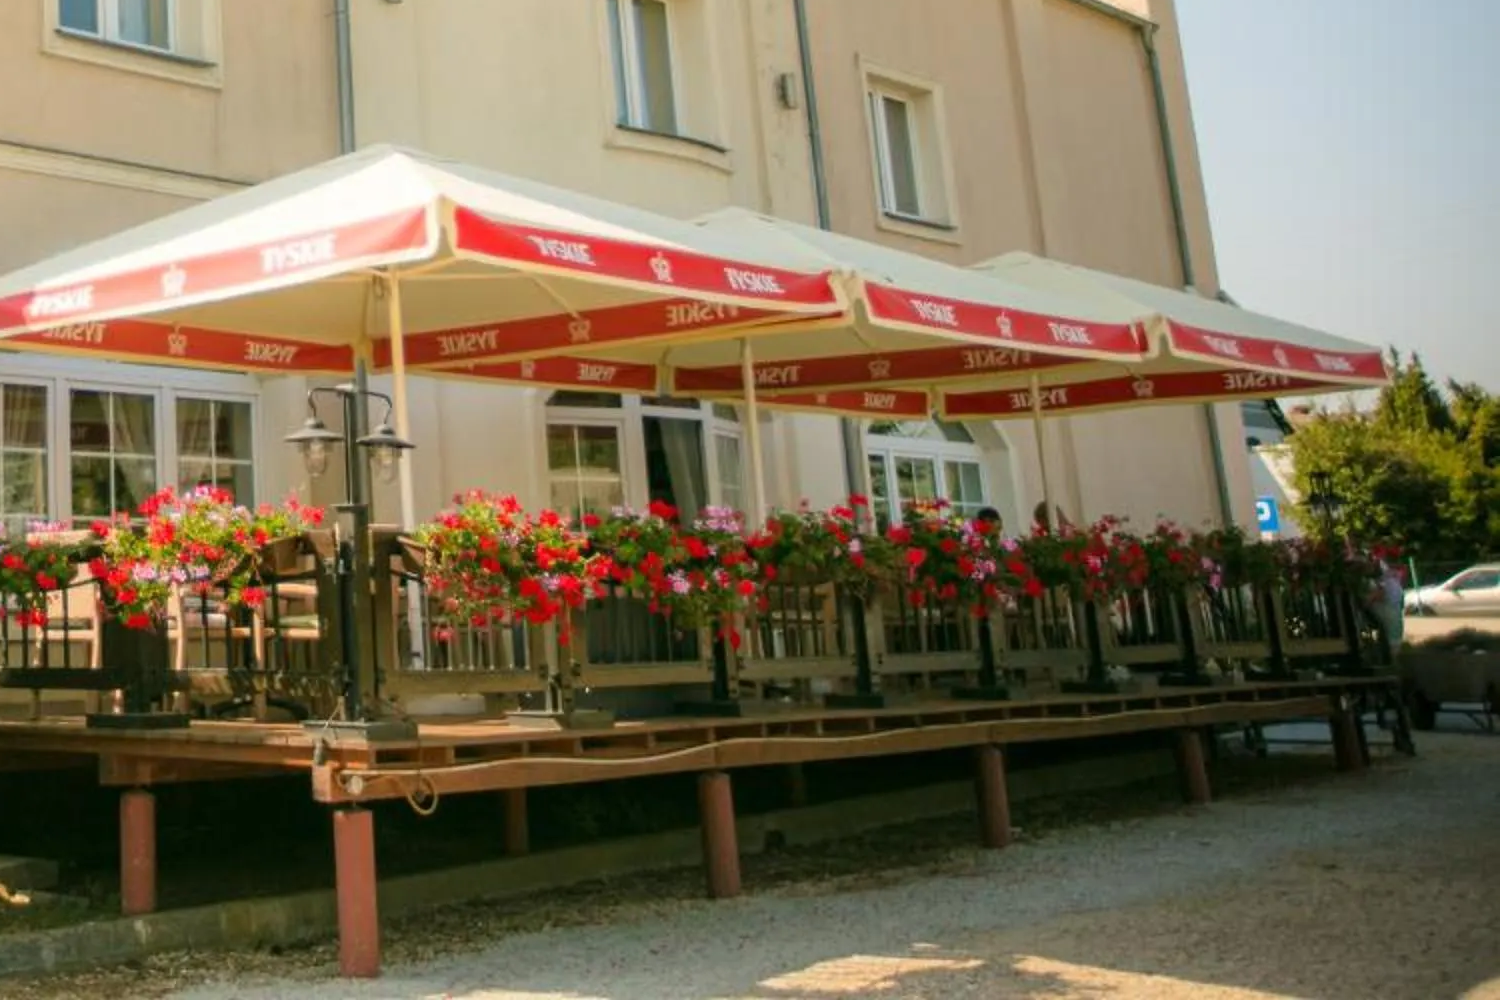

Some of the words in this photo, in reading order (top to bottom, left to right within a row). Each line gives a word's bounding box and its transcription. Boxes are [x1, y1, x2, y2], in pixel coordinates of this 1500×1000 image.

[260, 233, 337, 273] TYSKIE
[527, 236, 596, 266] TYSKIE
[723, 267, 786, 294] TYSKIE
[28, 284, 95, 317] TYSKIE
[909, 299, 958, 326] TYSKIE
[1047, 321, 1093, 345] TYSKIE
